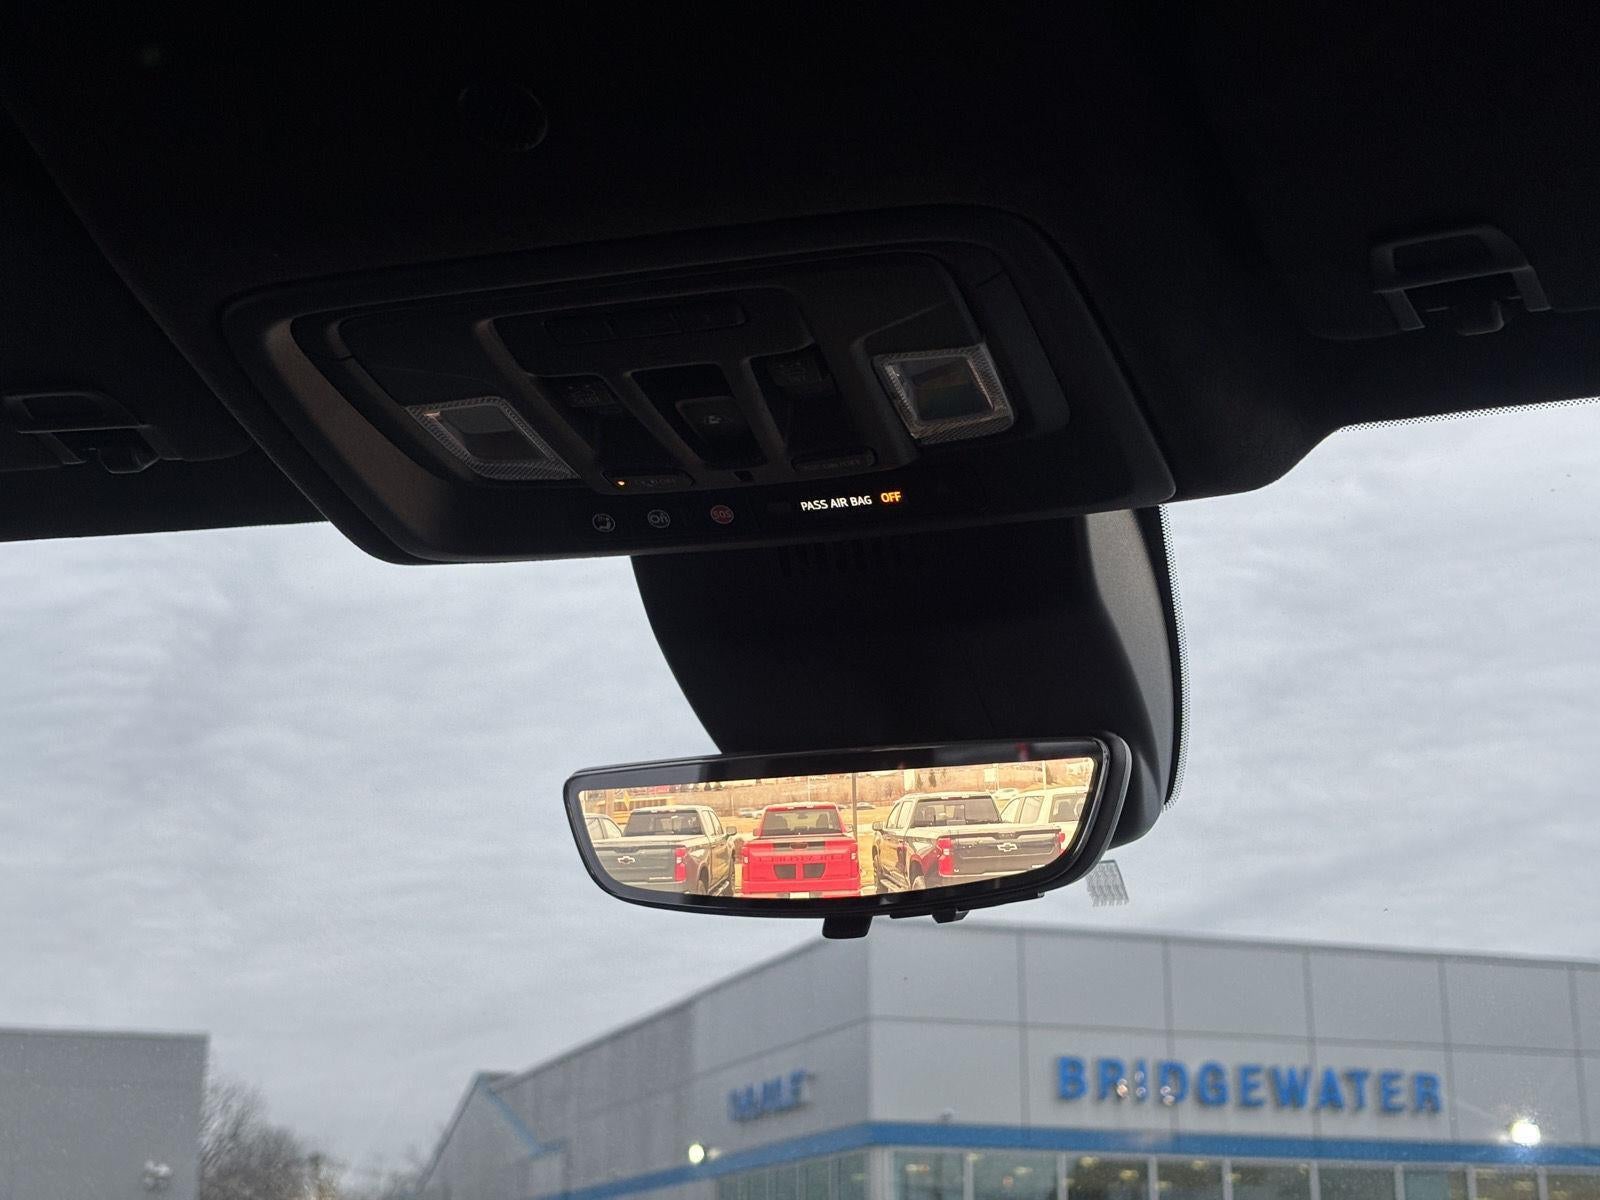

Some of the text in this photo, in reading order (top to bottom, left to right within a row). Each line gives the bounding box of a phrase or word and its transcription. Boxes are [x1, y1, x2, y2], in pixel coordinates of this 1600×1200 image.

[800, 491, 902, 511] PASS AIR BAG OFF
[713, 509, 731, 520] SOS
[1055, 1055, 1443, 1115] BRIDGEWATER
